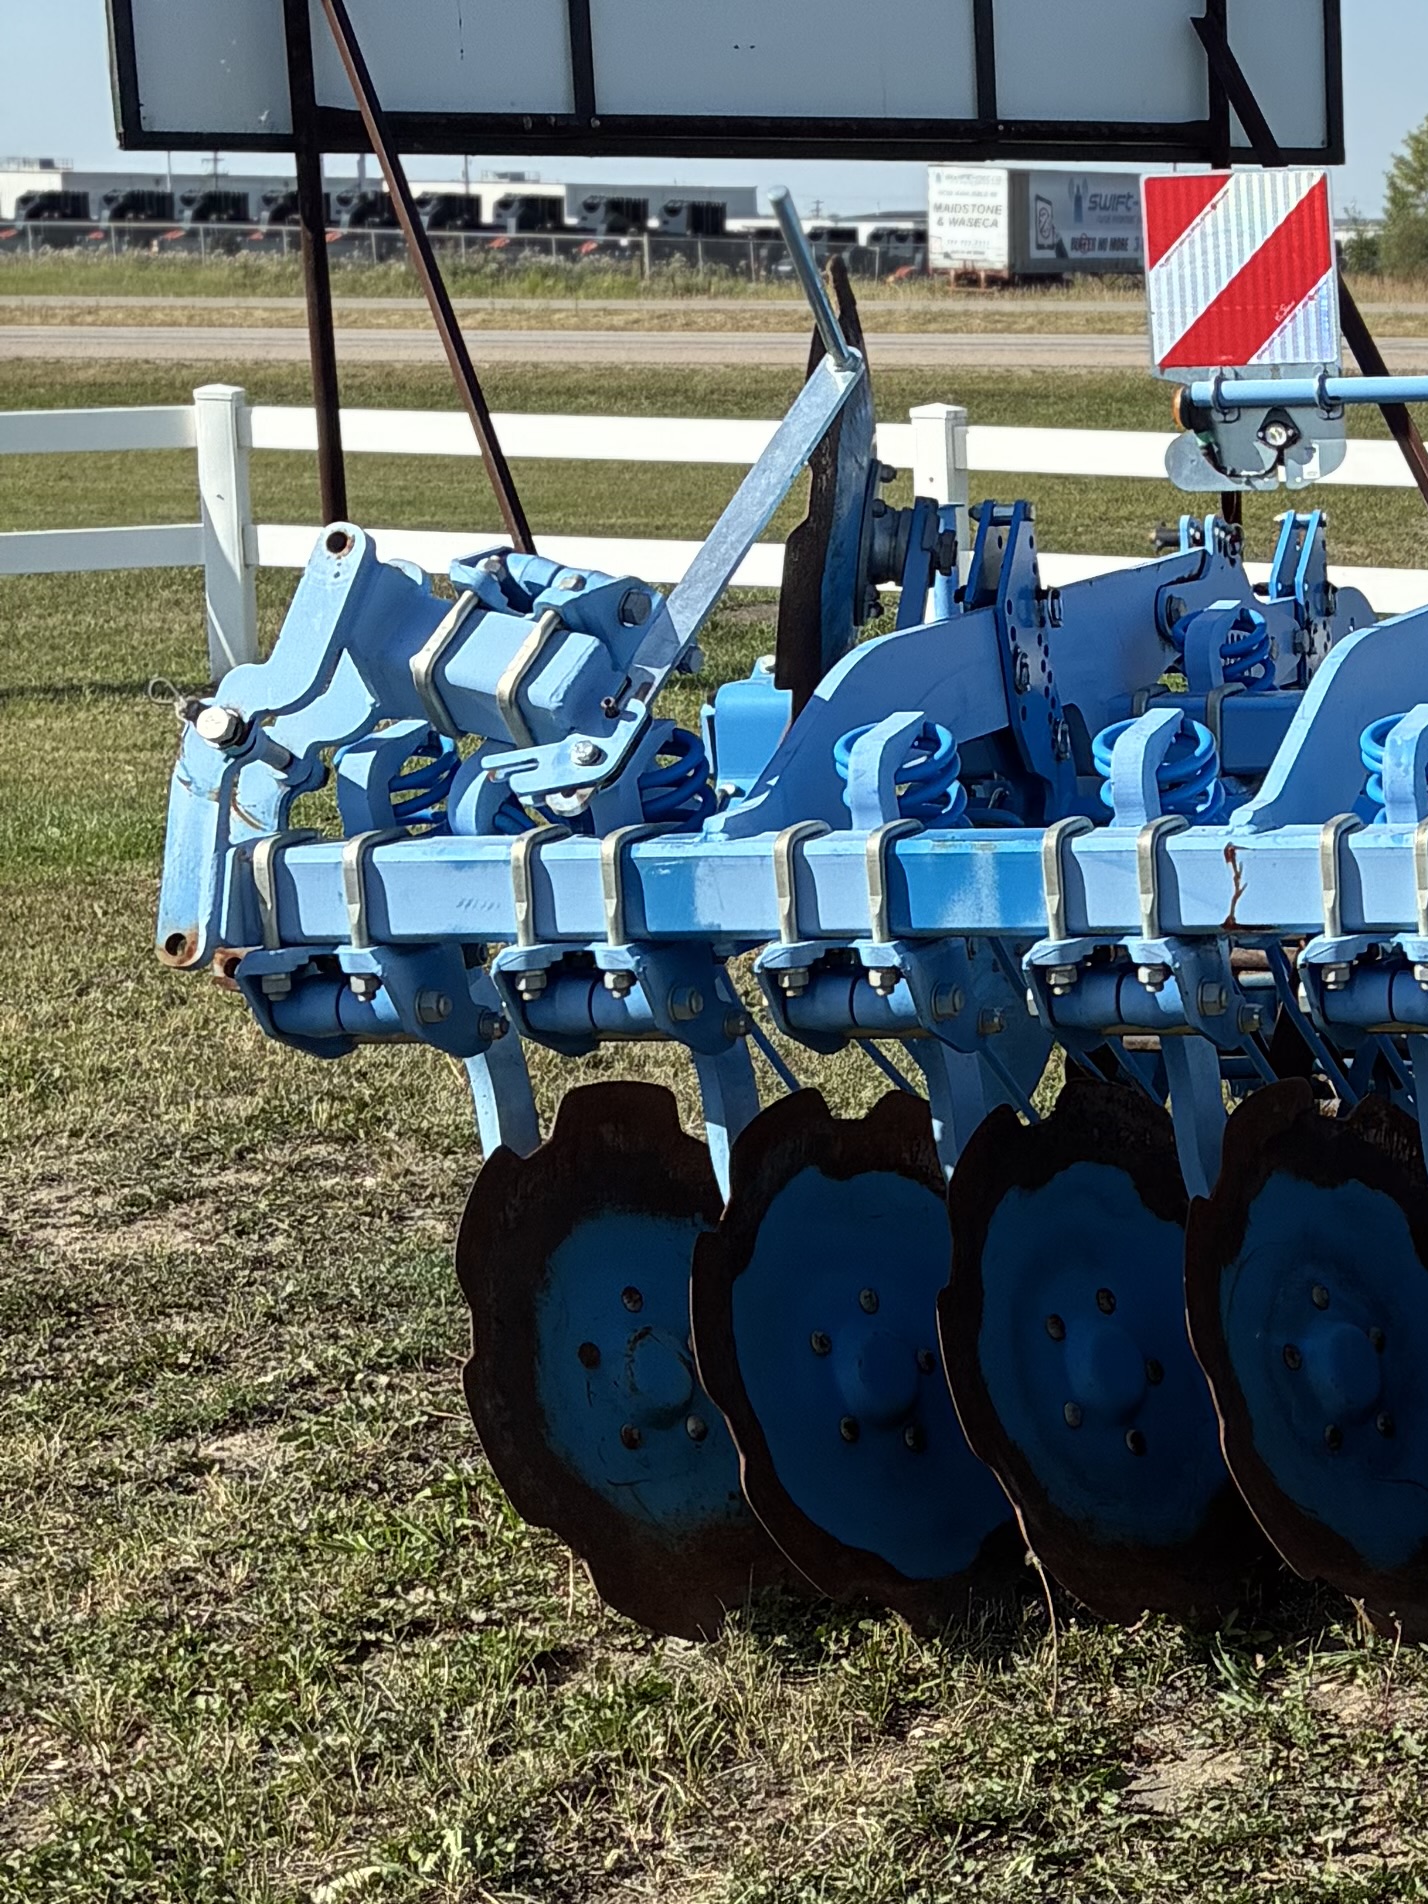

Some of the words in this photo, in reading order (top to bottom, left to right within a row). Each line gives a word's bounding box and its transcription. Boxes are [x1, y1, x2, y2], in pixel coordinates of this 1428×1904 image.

[933, 202, 1003, 216] MAIDSTONE
[936, 216, 945, 227] &
[949, 217, 999, 228] WASECA
